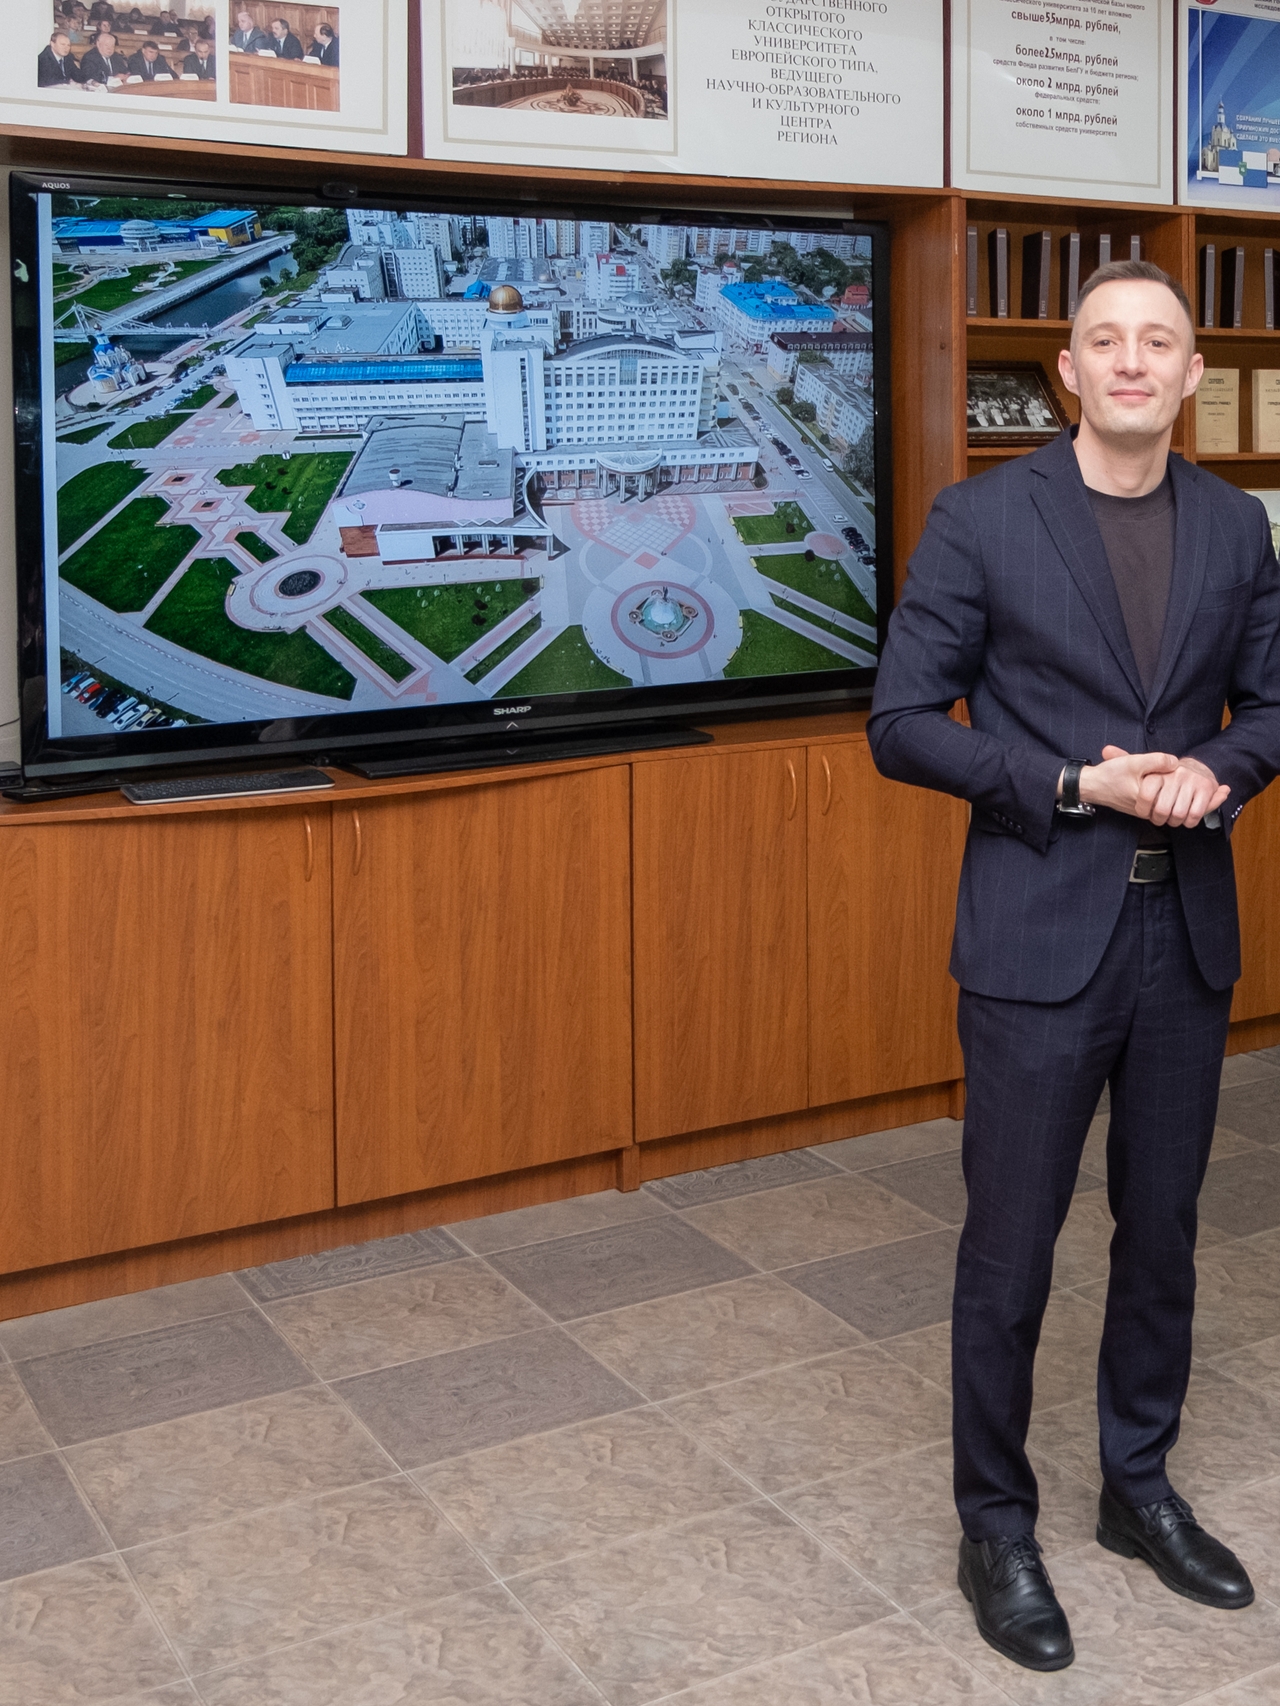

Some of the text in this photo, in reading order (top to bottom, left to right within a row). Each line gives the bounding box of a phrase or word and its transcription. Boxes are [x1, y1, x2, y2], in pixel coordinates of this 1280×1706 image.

[766, 6, 846, 24] ОТКРЫТОГО
[770, 0, 888, 14] РСТВЕННОГО
[1042, 2, 1081, 12] университета
[747, 19, 863, 41] КЛАССИЧЕСКОГО
[1085, 20, 1121, 34] рублей,
[753, 35, 857, 56] УНИВЕРСИТЕТА
[731, 48, 837, 69] ЕВРОПЕЙСКОГО
[993, 58, 1017, 67] средств
[1018, 60, 1037, 69] Фонда
[1038, 64, 1064, 73] развития
[1066, 66, 1084, 75] БелГУ
[1085, 55, 1118, 67] рублей
[770, 68, 843, 85] ВЕДУЩЕГО
[706, 78, 901, 105] НАУЧНО-ОБРАЗОВАТЕЛЬНОГО
[1016, 76, 1119, 97] около 2 млрд. рублей
[1035, 91, 1075, 102] федеральных
[752, 97, 860, 117] И КУЛЬТУРНОГО
[780, 115, 833, 130] ЦЕНТРА
[1016, 107, 1118, 126] около 1 млрд. рублей
[1015, 121, 1117, 137] собственных средств университета
[777, 130, 838, 145] РЕГИОНА
[42, 182, 71, 190] AQUOS
[493, 705, 532, 716] SHARP
